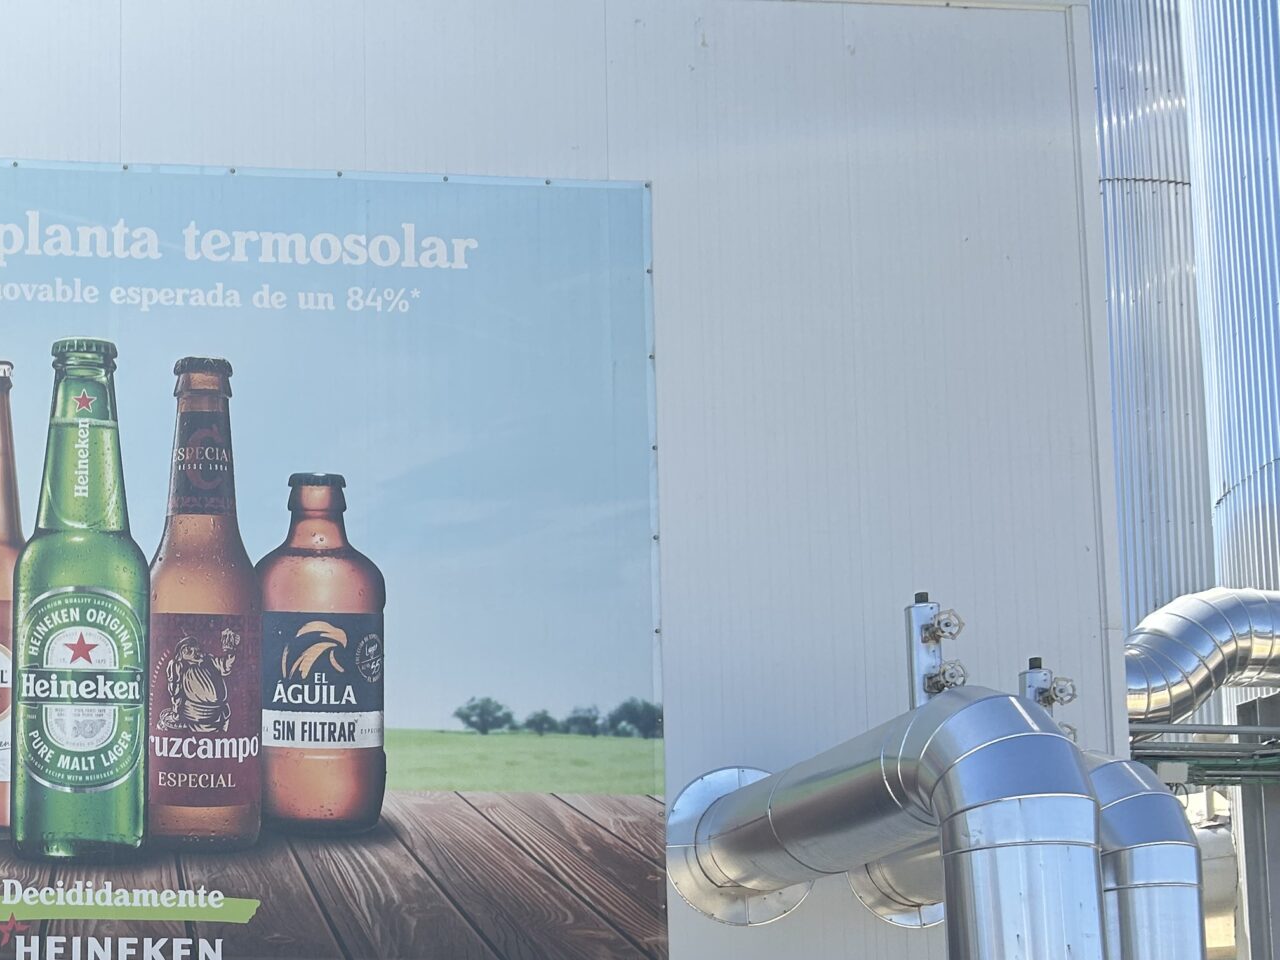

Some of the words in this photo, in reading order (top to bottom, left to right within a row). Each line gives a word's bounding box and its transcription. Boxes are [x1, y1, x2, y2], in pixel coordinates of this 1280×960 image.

[183, 220, 478, 269] termosolar
[110, 282, 241, 312] esperada
[252, 284, 287, 309] de
[298, 293, 335, 310] un
[73, 417, 90, 499] Heineken
[28, 607, 80, 656] HEINEKEN
[86, 608, 134, 658] ORIGINAL
[21, 673, 140, 700] Heineken
[272, 680, 357, 705] ÁGUILA
[314, 672, 328, 684] EL
[273, 719, 296, 741] SIN
[301, 721, 356, 742] FILTRAR
[29, 730, 54, 763] PURE
[57, 754, 95, 771] MALT
[100, 731, 132, 767] LAGER
[158, 771, 236, 788] ESPECIAL
[2, 879, 224, 908] Decididamente
